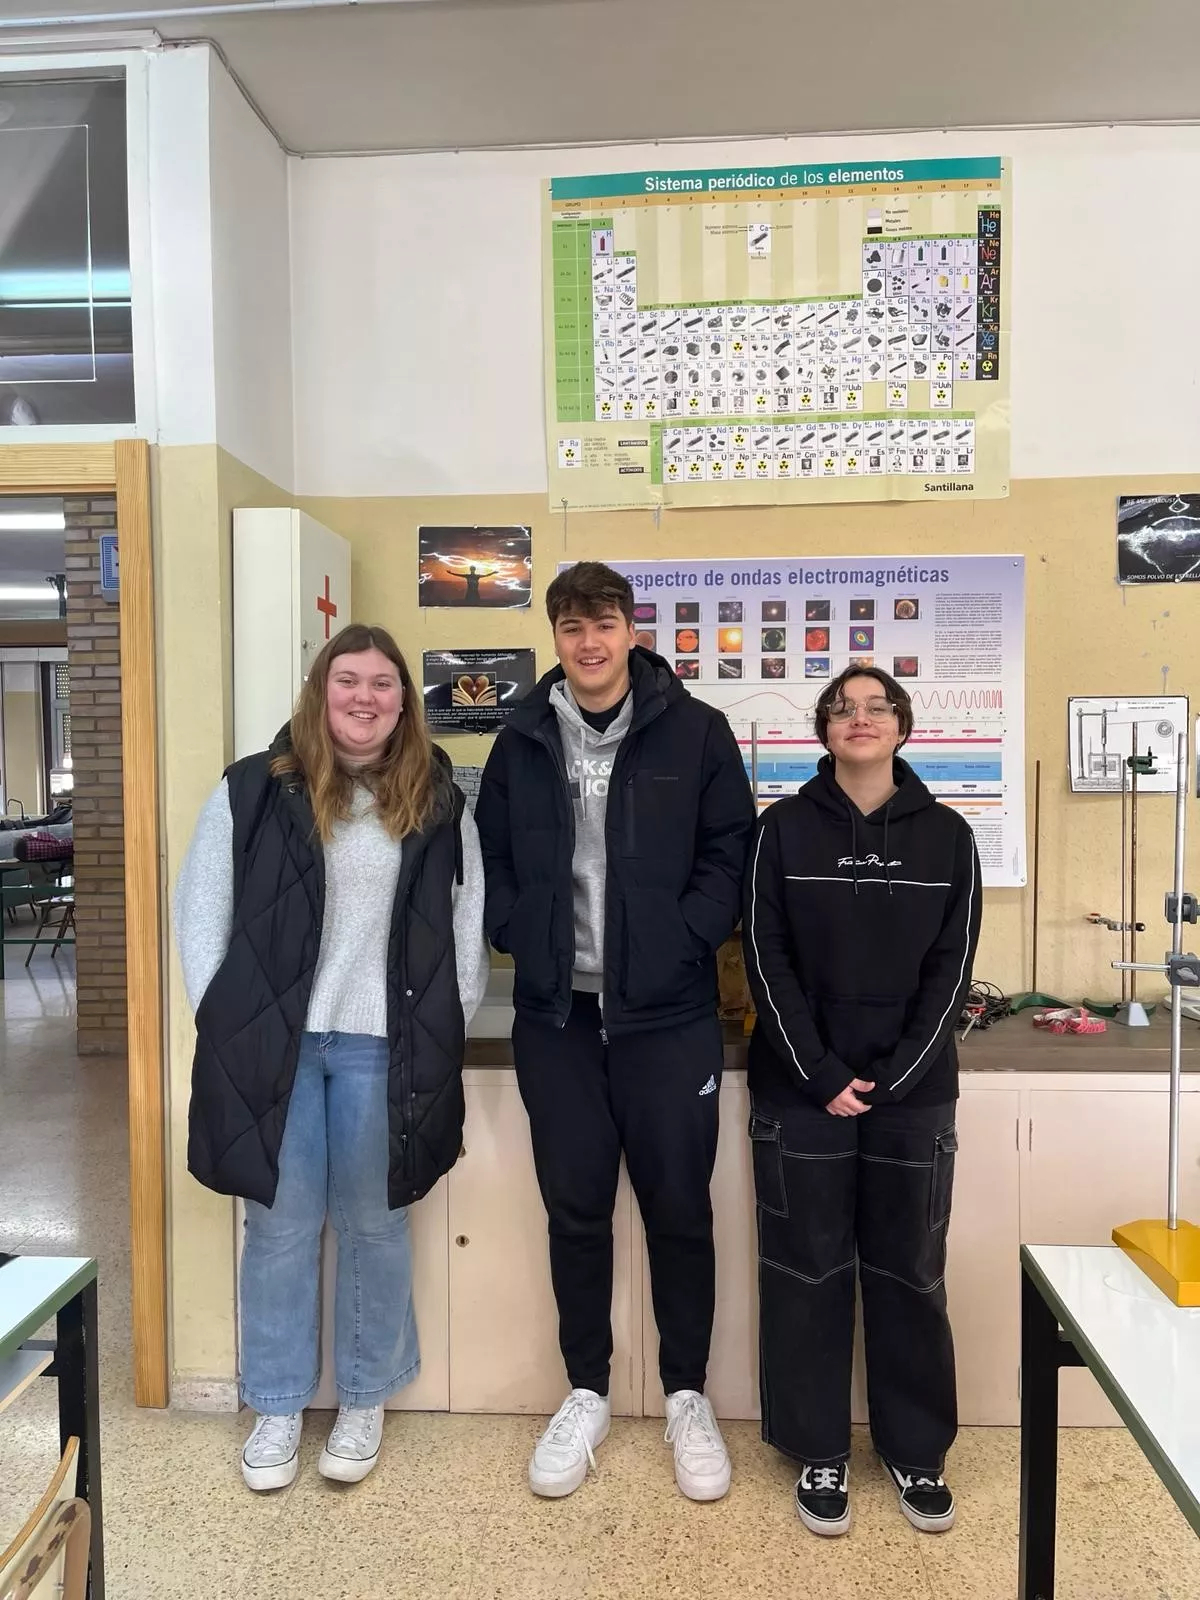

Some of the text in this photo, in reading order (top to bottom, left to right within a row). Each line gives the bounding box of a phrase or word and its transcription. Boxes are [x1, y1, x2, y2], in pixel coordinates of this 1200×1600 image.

[645, 168, 904, 191] Sistema periódico de los elementos
[982, 218, 997, 232] He
[981, 248, 996, 260] Ne
[980, 276, 996, 289] Ar
[625, 285, 636, 293] Mg
[981, 303, 995, 318] Kr
[829, 330, 838, 338] Ag
[852, 357, 861, 365] Hg
[829, 385, 839, 393] Rg
[894, 382, 906, 390] Uuq
[739, 454, 749, 462] Np
[924, 483, 974, 491] Santillana
[627, 566, 949, 590] espectro de ondas electromagnéticas
